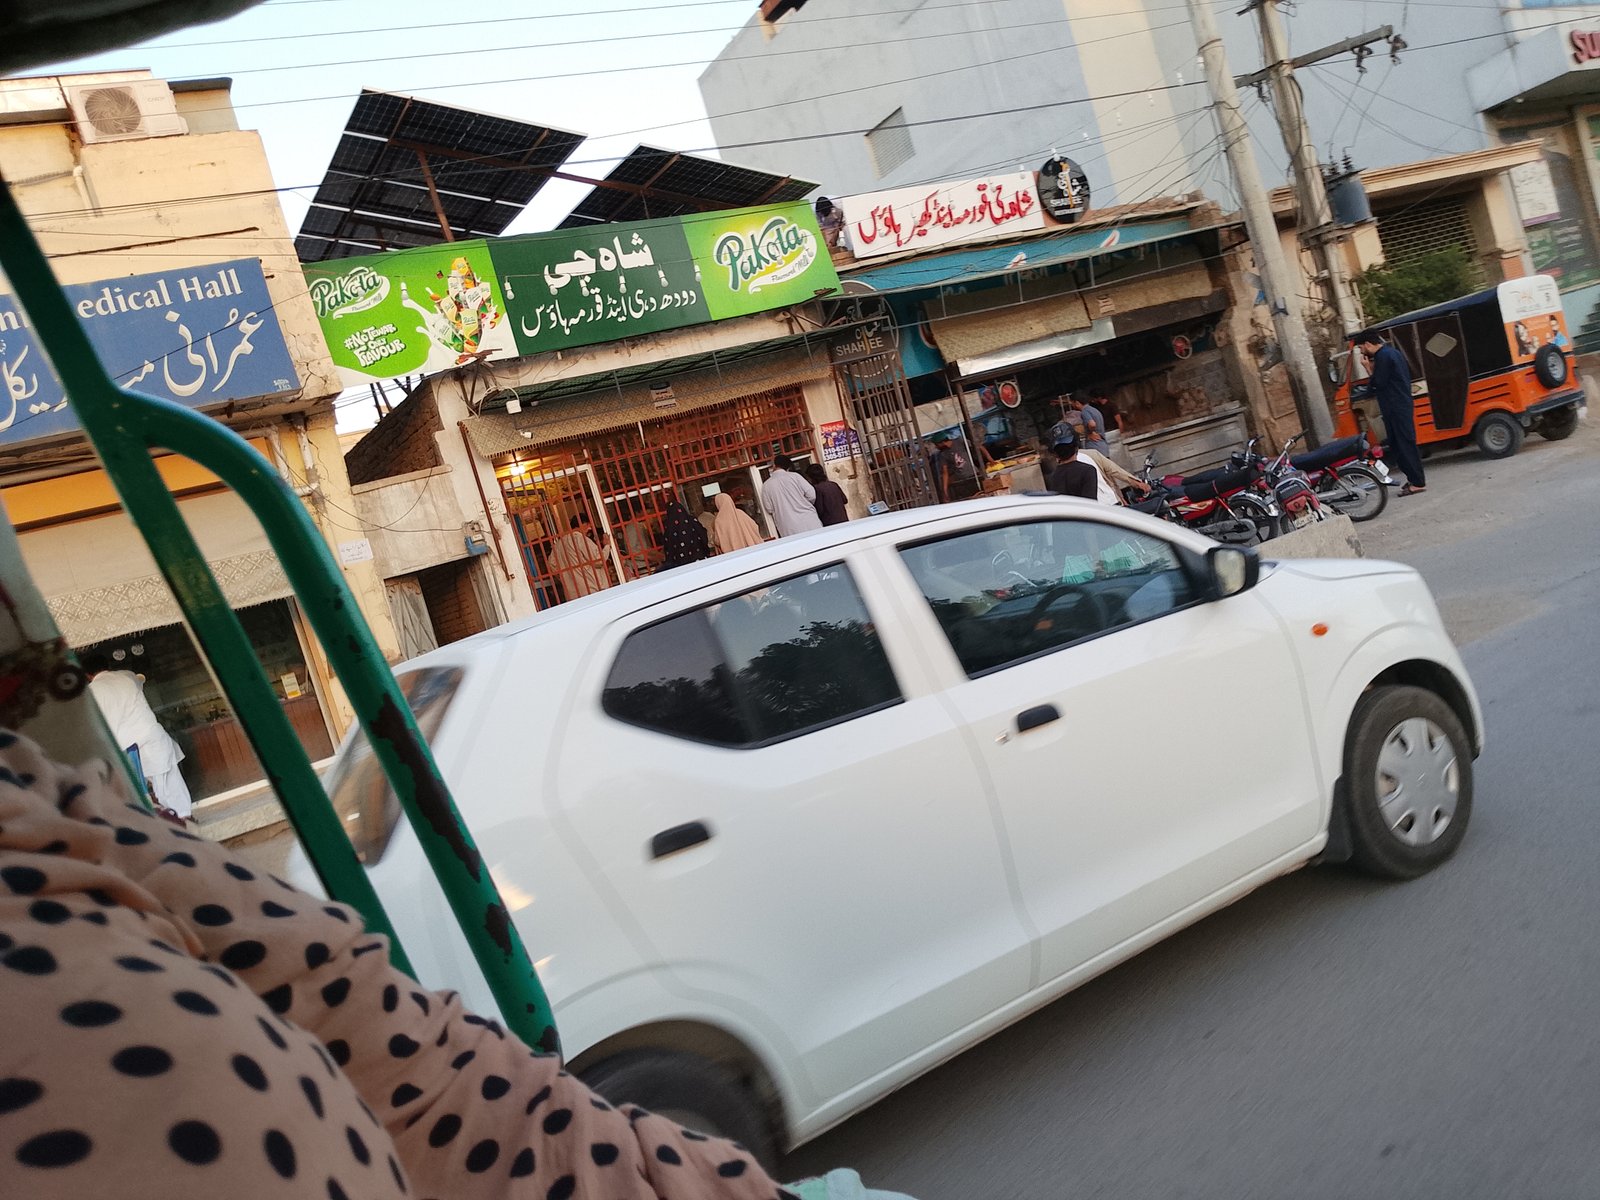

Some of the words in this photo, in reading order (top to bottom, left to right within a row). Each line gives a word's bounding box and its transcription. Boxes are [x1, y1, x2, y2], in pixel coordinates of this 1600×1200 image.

[544, 249, 596, 288] جی
[600, 231, 655, 271] شاہ
[715, 216, 809, 292] Pakola
[77, 278, 174, 319] edical
[177, 268, 243, 303] Hall
[310, 266, 384, 318] Pakola
[568, 286, 603, 327] قورمہ
[606, 293, 627, 322] اینڈ
[628, 288, 657, 319] دہی
[660, 289, 697, 311] دودھ
